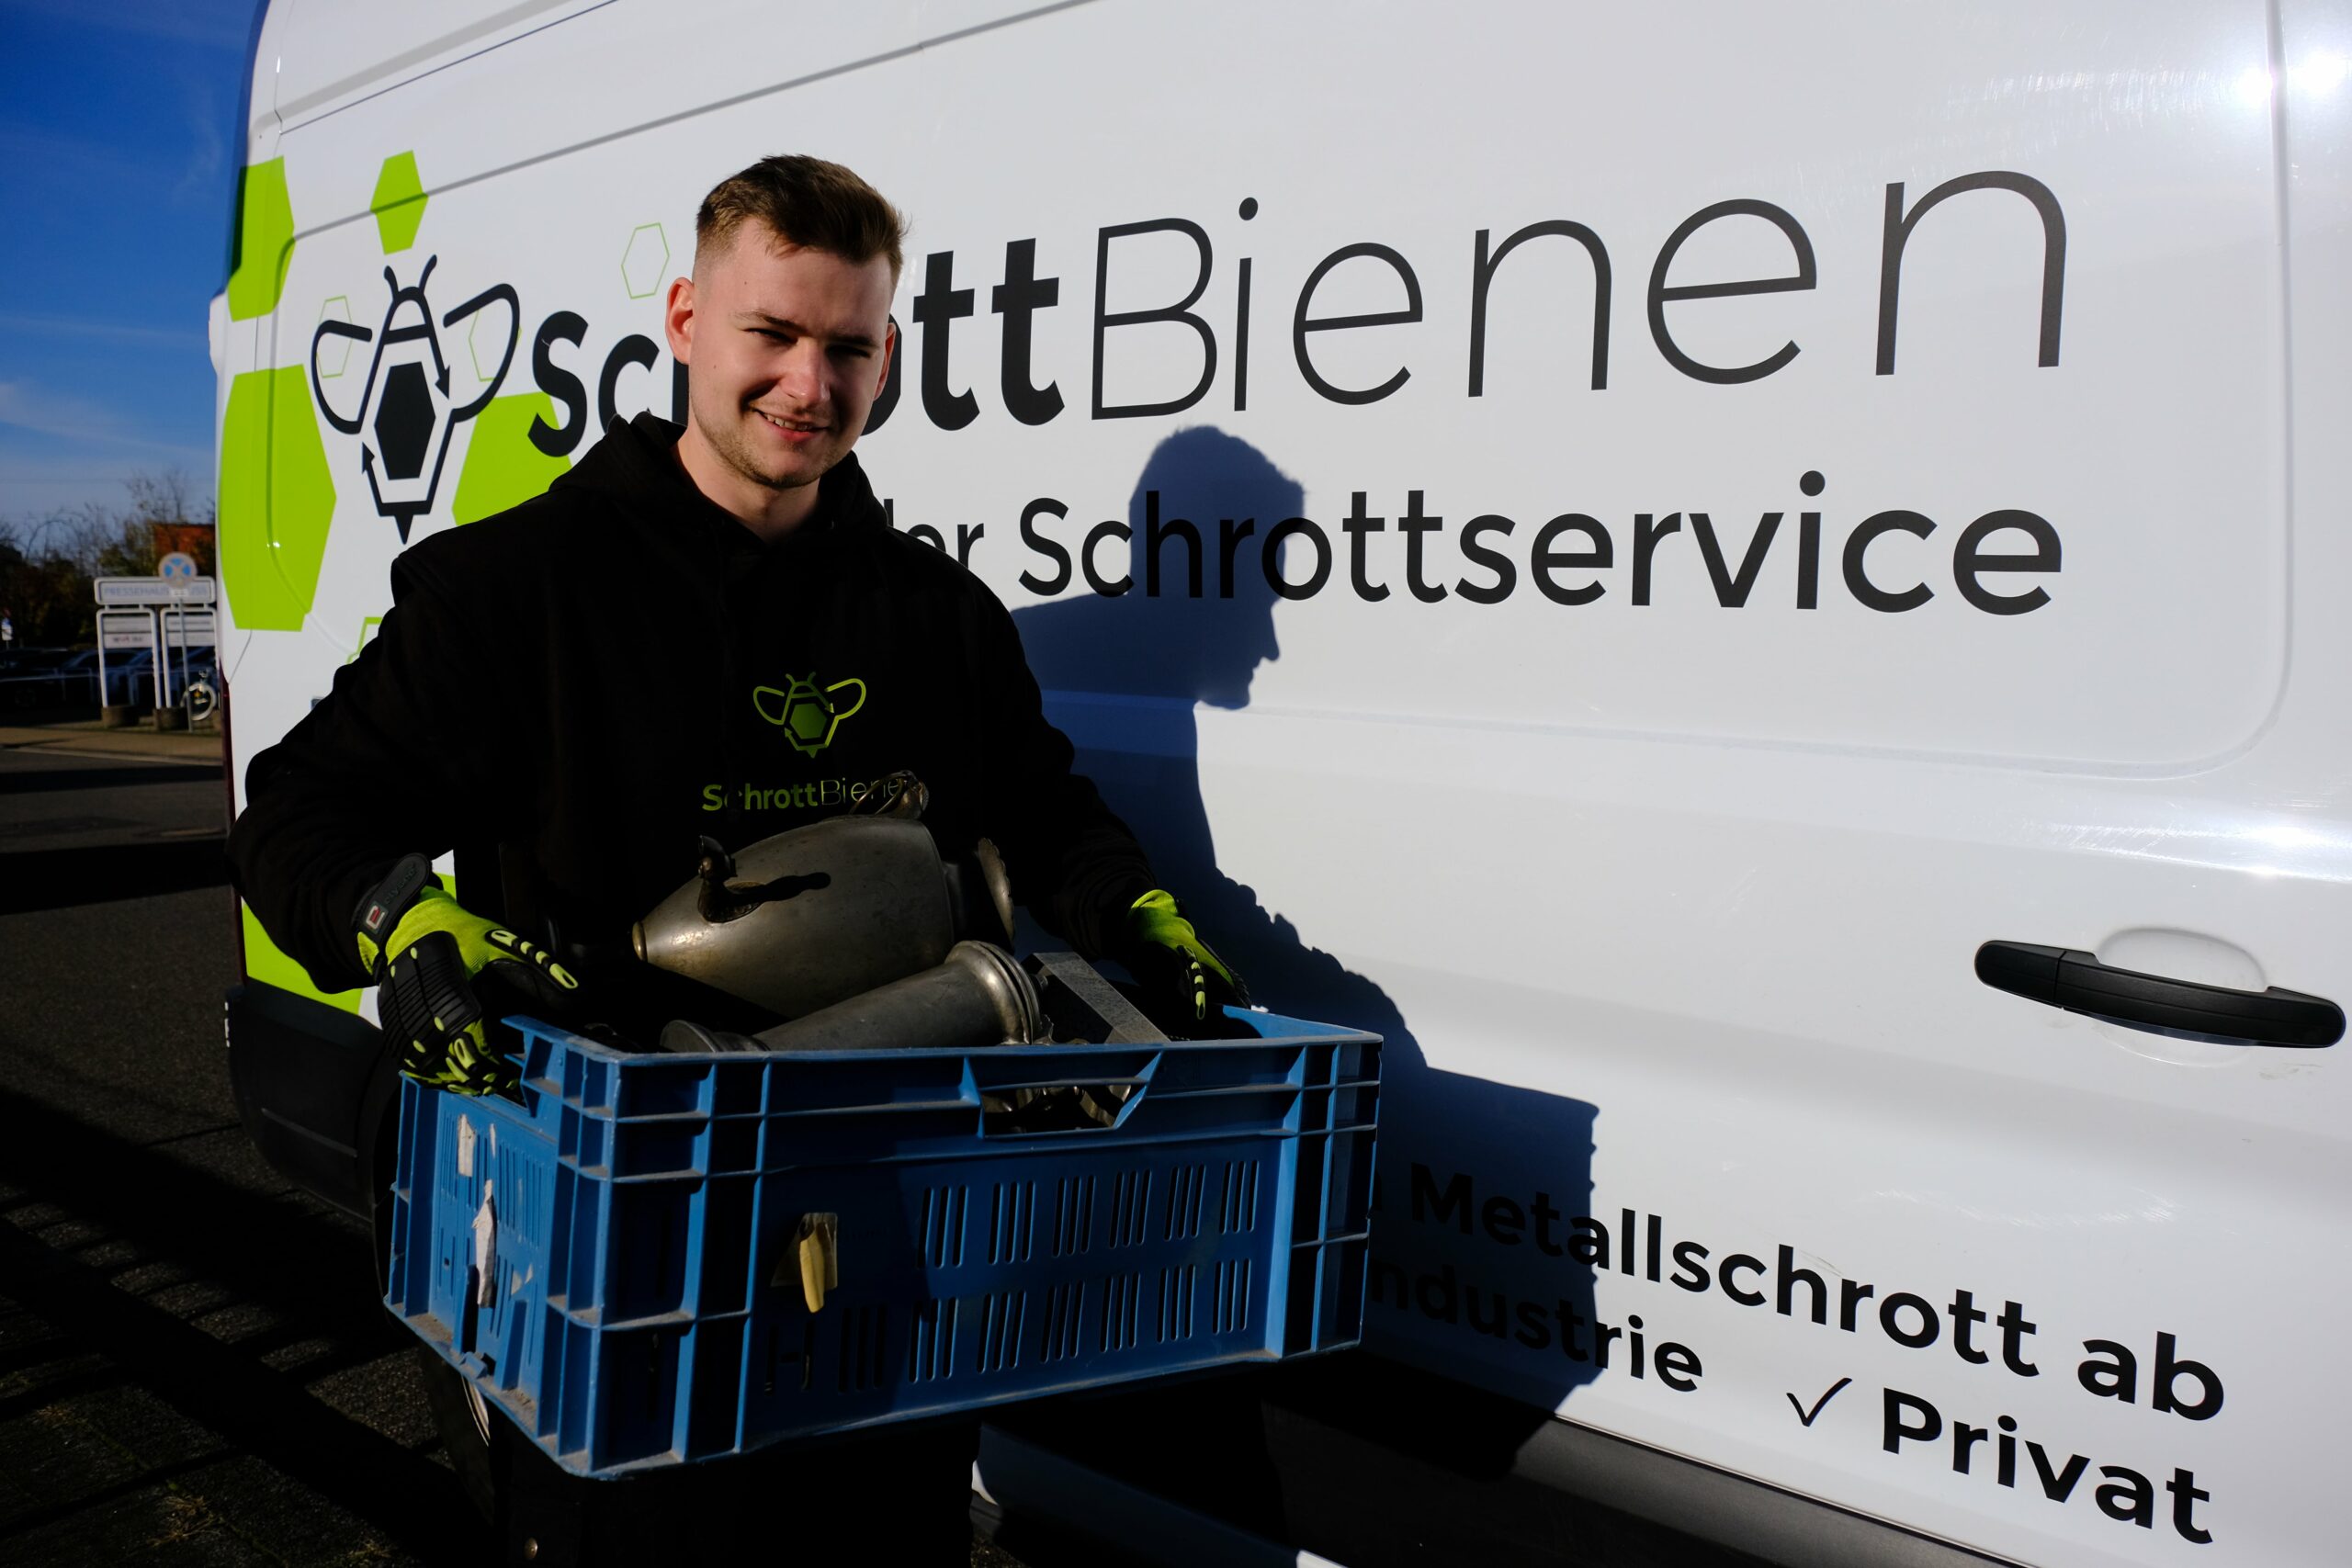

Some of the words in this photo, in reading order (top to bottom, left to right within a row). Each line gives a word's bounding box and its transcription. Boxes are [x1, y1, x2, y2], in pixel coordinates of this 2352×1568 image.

[526, 171, 2066, 457] ScttBienen
[1018, 470, 2062, 616] Schrottservice
[1372, 1258, 1702, 1393] ndustrie
[1883, 1387, 2213, 1545] Privat
[1412, 1162, 2040, 1378] Metallschrott
[2077, 1331, 2224, 1421] ab
